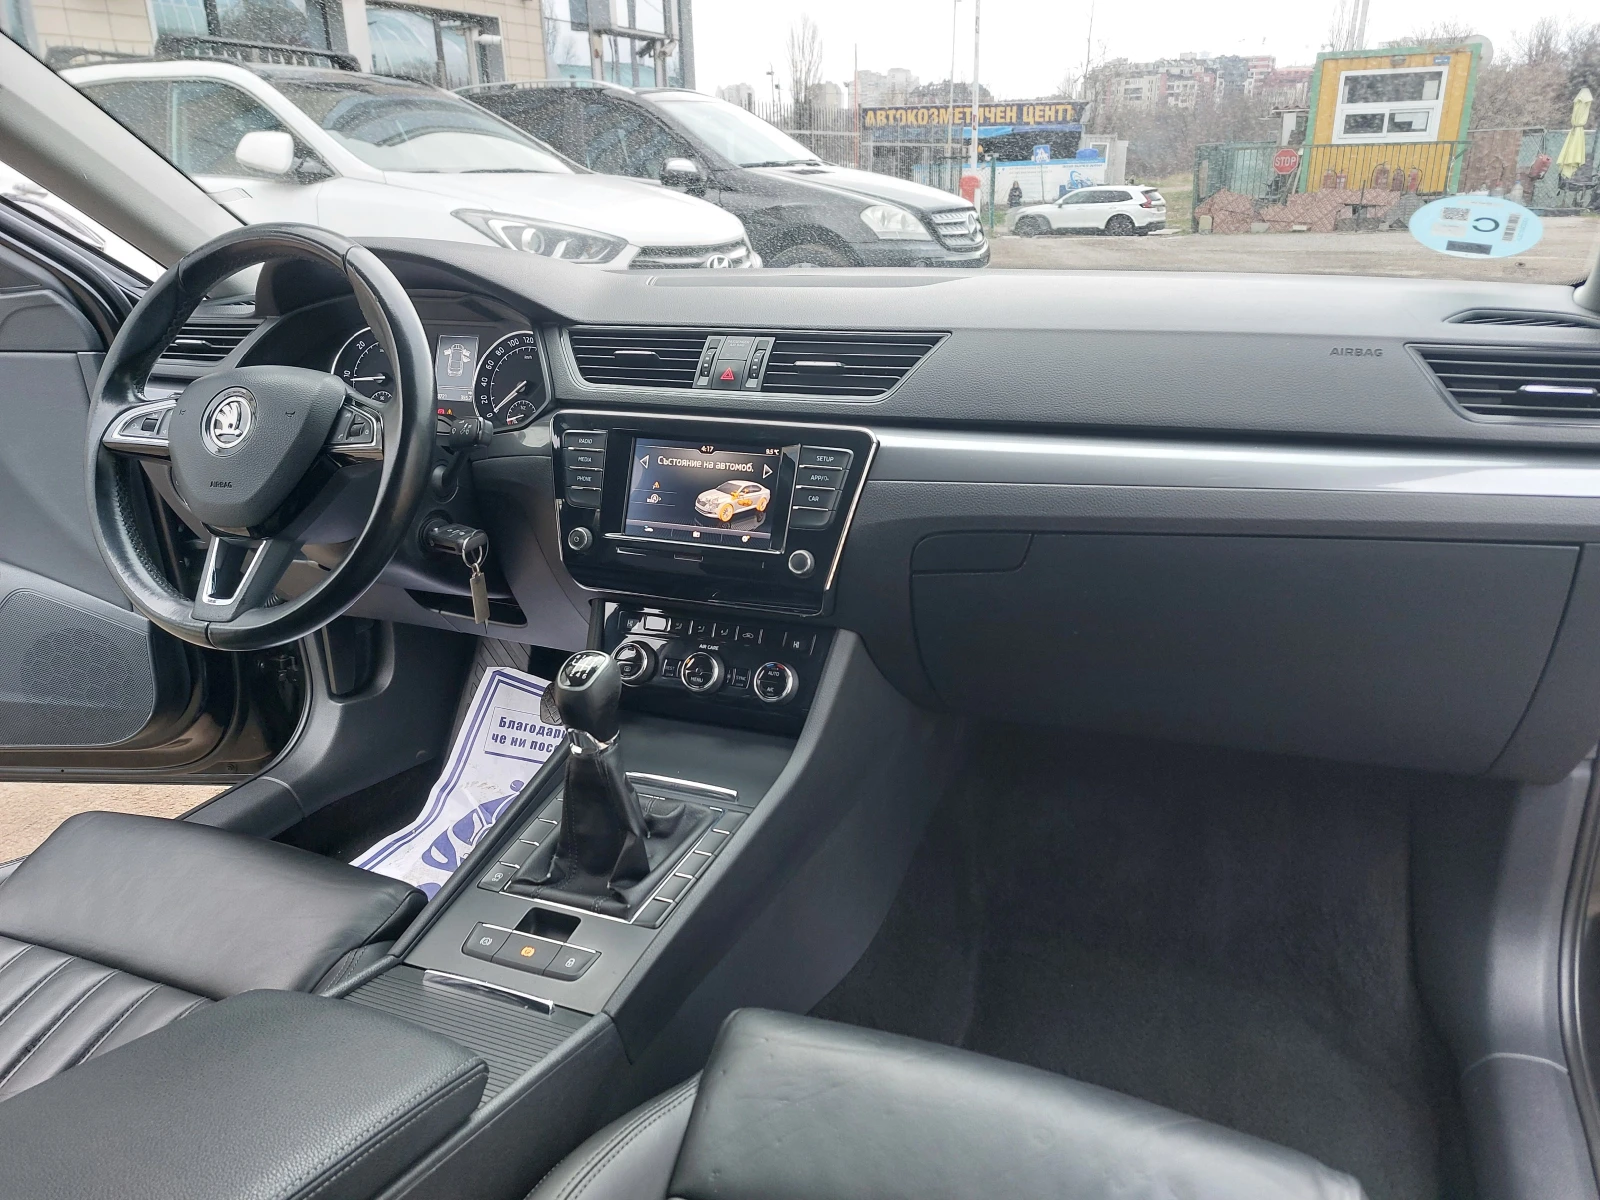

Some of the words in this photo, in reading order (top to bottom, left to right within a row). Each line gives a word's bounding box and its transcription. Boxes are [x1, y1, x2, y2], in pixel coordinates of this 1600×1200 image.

[1274, 156, 1297, 167] STOP
[356, 340, 366, 350] 20
[507, 337, 520, 348] 100
[522, 336, 534, 344] 120
[495, 346, 505, 356] 80
[1329, 347, 1383, 357] AIRBAG
[485, 360, 495, 370] 60
[343, 369, 351, 378] 10
[481, 377, 489, 387] 40
[480, 394, 488, 404] 20
[701, 445, 714, 453] 4:17
[657, 456, 702, 468] Състояние
[703, 461, 714, 469] на
[209, 480, 233, 489] AIRBAG
[491, 732, 507, 745] че
[510, 736, 527, 748] ни
